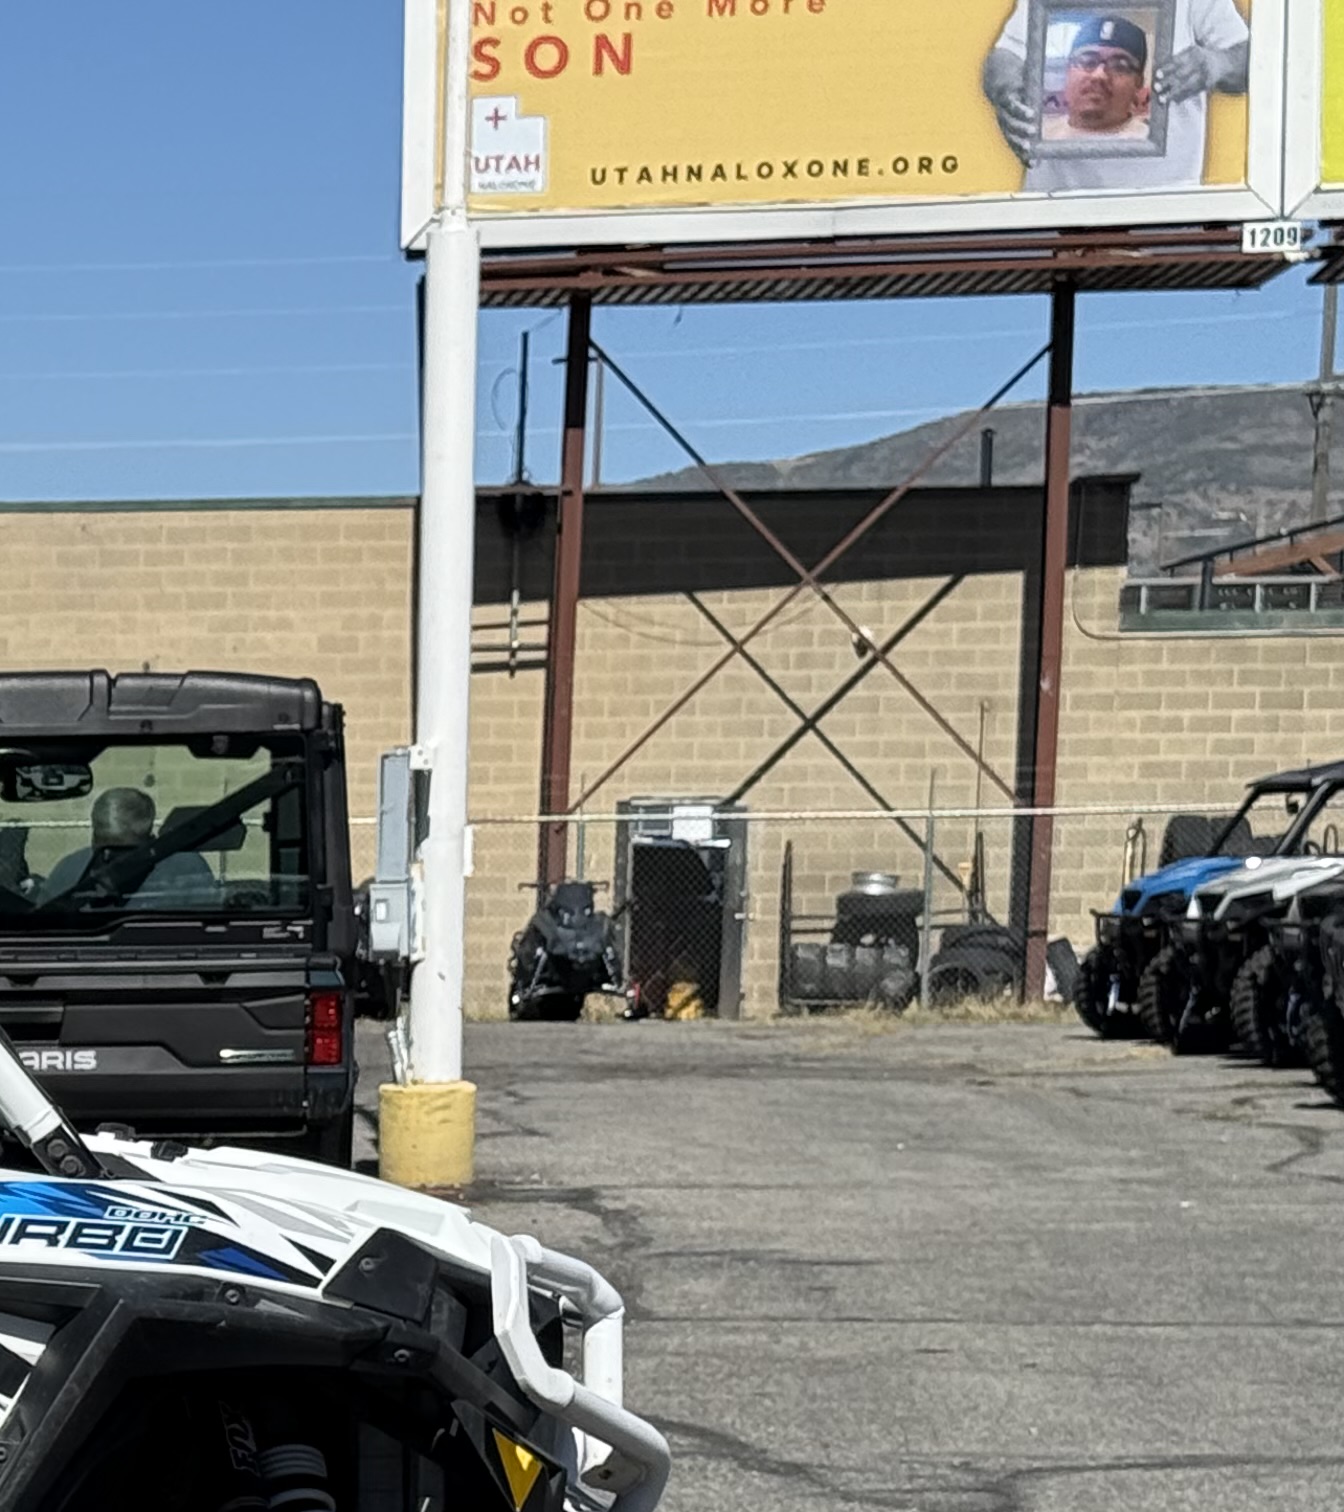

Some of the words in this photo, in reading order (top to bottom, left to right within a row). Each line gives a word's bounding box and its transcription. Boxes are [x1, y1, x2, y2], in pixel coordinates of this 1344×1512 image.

[472, 0, 554, 26] Not
[583, 0, 674, 22] One
[706, 0, 826, 17] More
[470, 32, 633, 82] SON
[473, 154, 541, 175] UTAH
[590, 155, 960, 186] UTAHNALOXONE.ORG
[1250, 227, 1298, 248] 1209
[19, 1050, 97, 1070] ARIS
